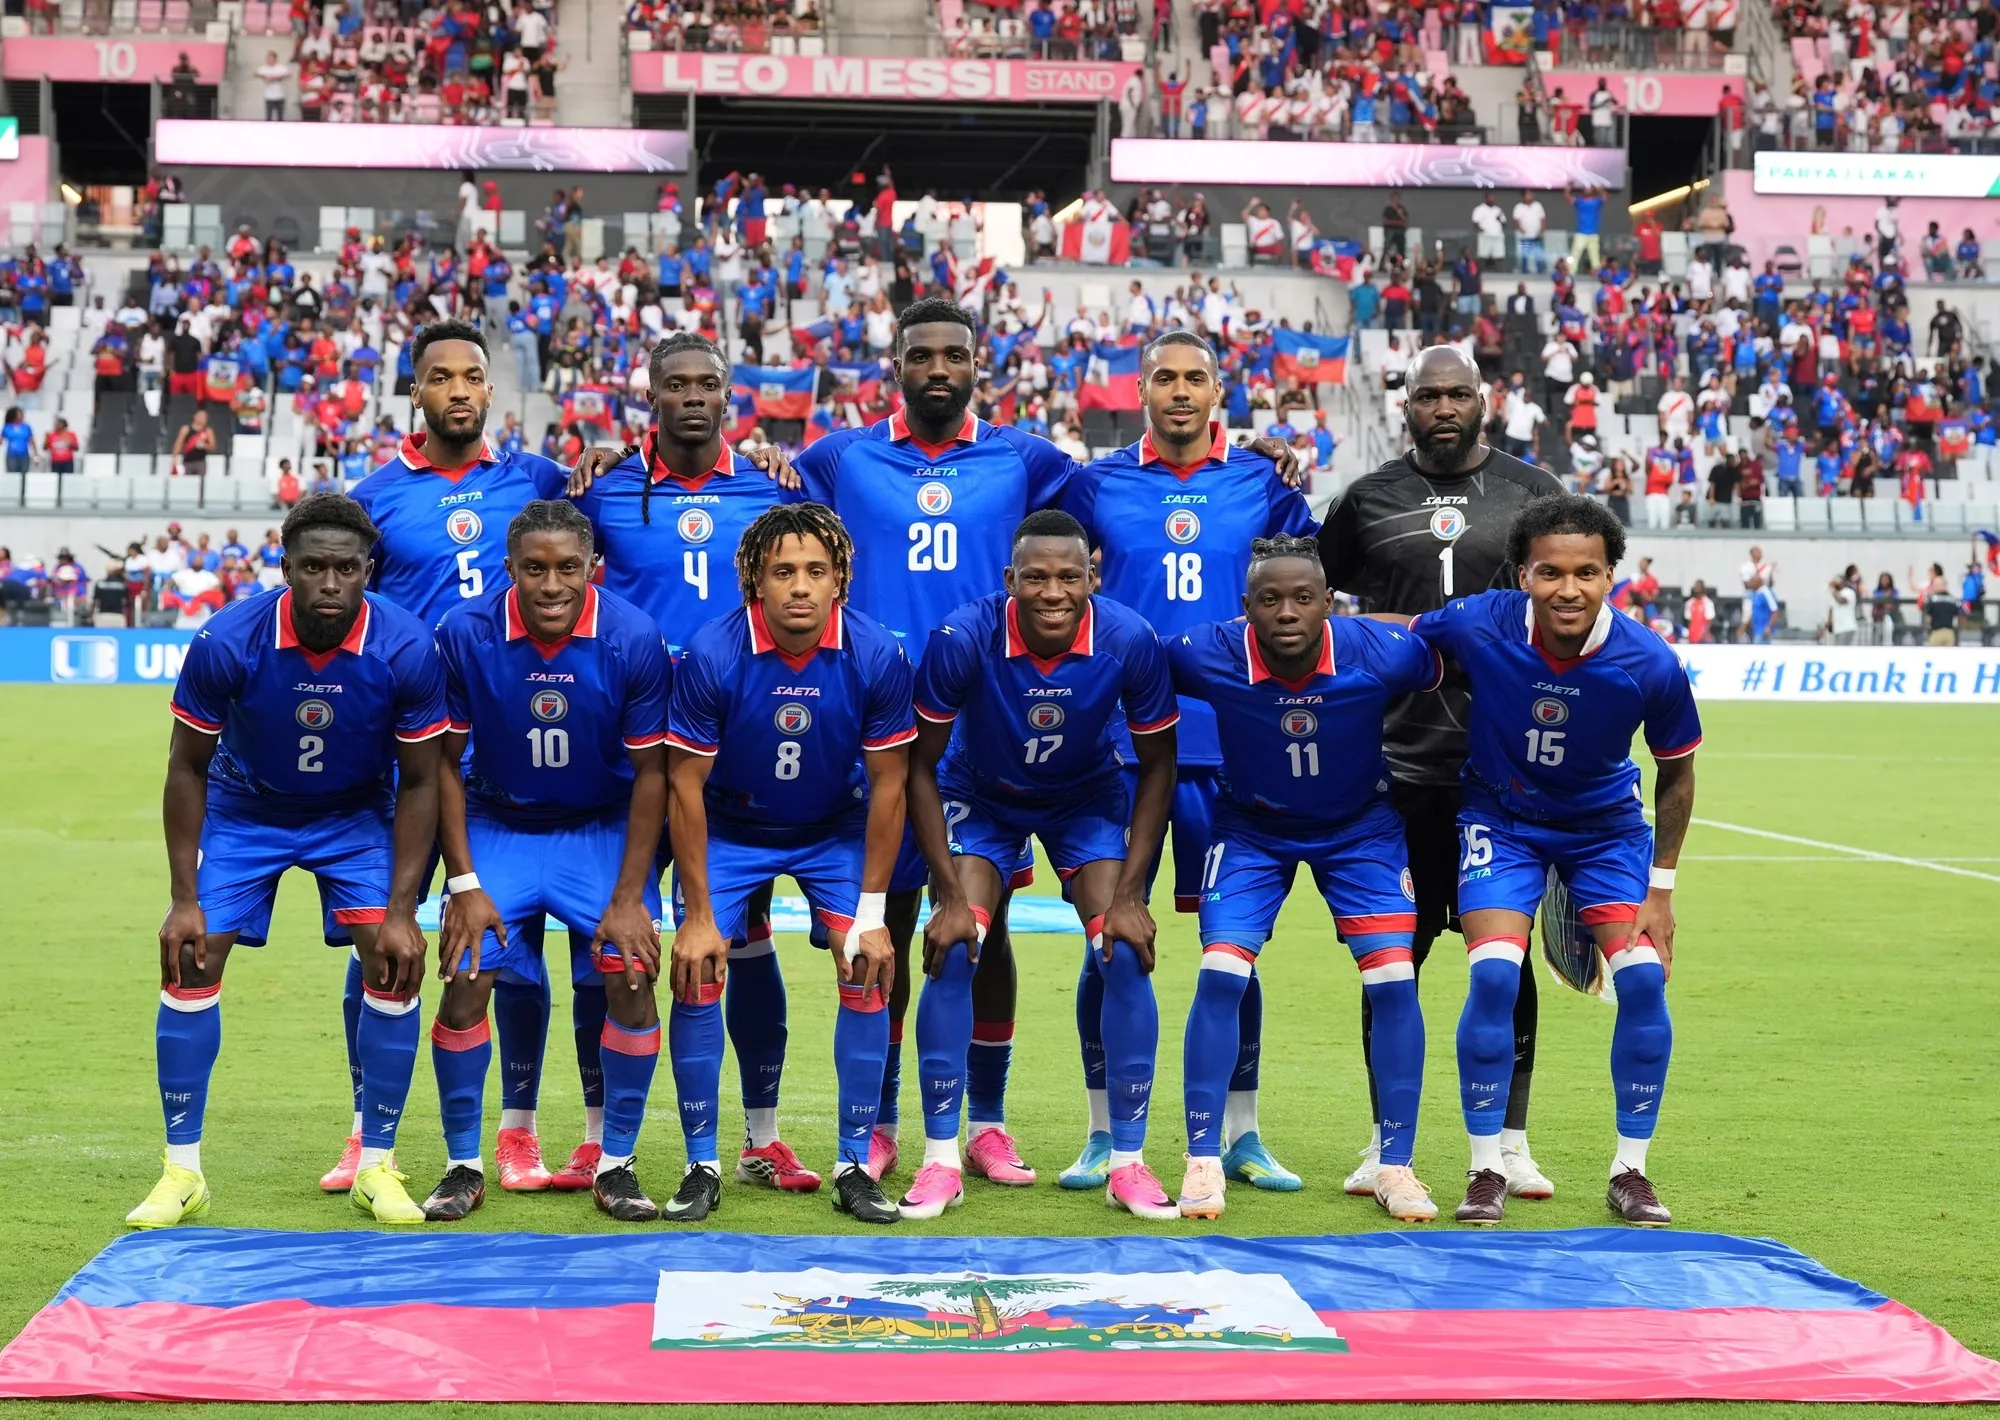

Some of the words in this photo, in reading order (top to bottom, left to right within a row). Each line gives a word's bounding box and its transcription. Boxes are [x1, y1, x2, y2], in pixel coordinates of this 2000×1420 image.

[95, 41, 137, 80] 10
[662, 54, 788, 92] LEO
[812, 59, 1011, 98] MESSI
[1025, 70, 1116, 93] STAND
[1623, 76, 1664, 113] 10
[912, 467, 958, 477] SAETA
[437, 491, 483, 507] SAETA
[672, 496, 720, 504] SAETA
[1161, 494, 1208, 504] SAETA
[1421, 496, 1469, 505] SAETA
[909, 522, 957, 571] 20
[456, 550, 483, 598] 5
[684, 551, 708, 600] 4
[1162, 552, 1202, 601] 18
[1438, 547, 1454, 596] 1
[526, 673, 574, 682] SAETA
[1742, 660, 1786, 692] #1
[1799, 661, 1905, 693] Bank
[1921, 662, 1957, 694] in
[1973, 662, 2000, 694] H
[293, 683, 342, 693] SAETA
[772, 687, 820, 696] SAETA
[1024, 688, 1072, 696] SAETA
[1531, 681, 1580, 697] SAETA
[1274, 695, 1323, 704] SAETA
[527, 728, 569, 767] 10
[1024, 735, 1063, 763] 17
[1525, 729, 1566, 766] 15
[298, 736, 323, 772] 2
[1286, 743, 1319, 777] 11
[775, 742, 801, 779] 8
[1462, 824, 1493, 870] 15
[1201, 842, 1225, 890] 11
[1515, 1035, 1530, 1044] HF
[1239, 1042, 1259, 1051] HF
[351, 1066, 363, 1074] FH
[510, 1062, 535, 1071] FHF
[760, 1064, 781, 1074] FHF
[935, 1079, 957, 1089] FHF
[1131, 1080, 1152, 1093] FHF
[1471, 1082, 1499, 1092] FHF
[1632, 1082, 1658, 1093] FHF
[165, 1091, 192, 1103] FHF
[378, 1104, 400, 1116] FHF
[683, 1101, 707, 1112] FHF
[851, 1105, 876, 1114] FHF
[1189, 1111, 1210, 1121] FHF
[1383, 1119, 1403, 1130] FHF
